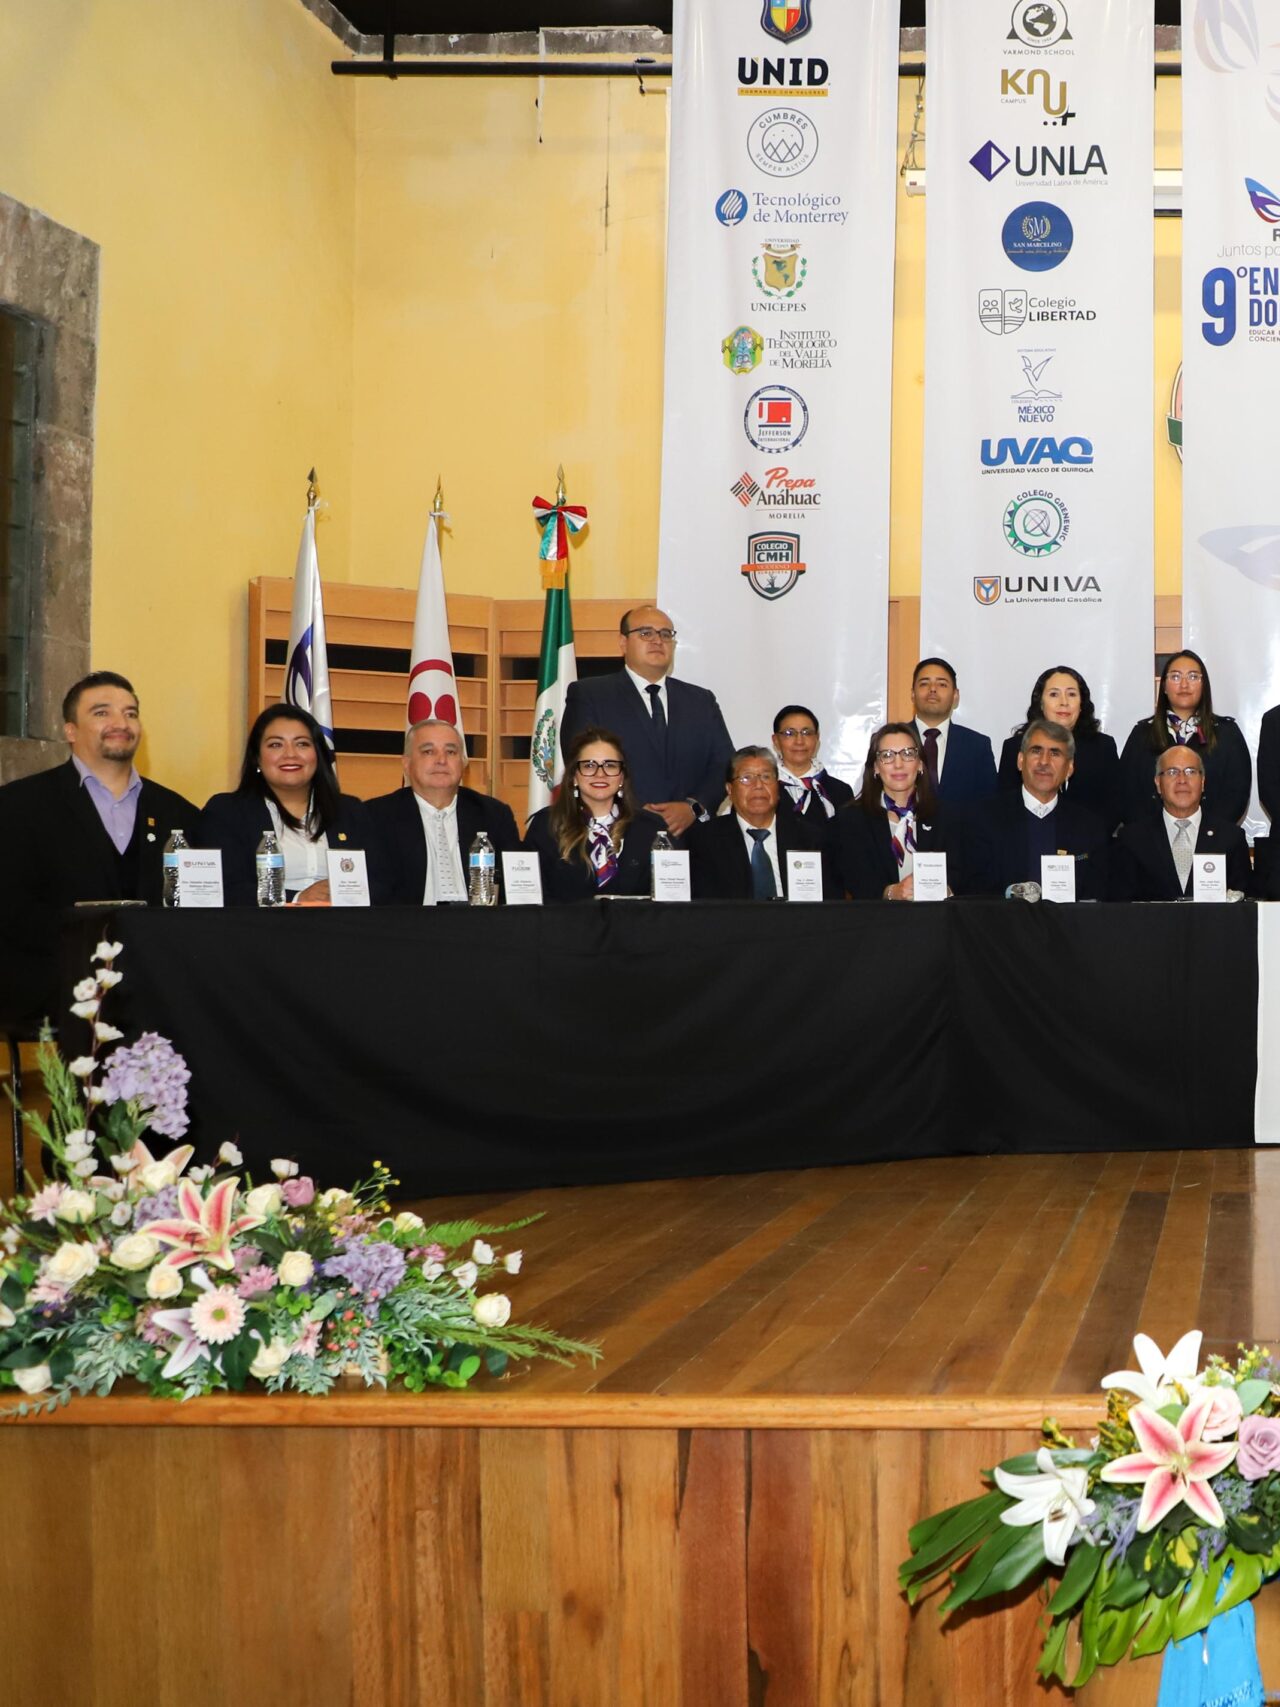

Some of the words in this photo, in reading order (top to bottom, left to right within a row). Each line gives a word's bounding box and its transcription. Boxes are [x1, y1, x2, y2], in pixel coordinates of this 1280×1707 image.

[737, 57, 829, 86] UNID
[758, 112, 808, 130] CUMBRES
[755, 152, 782, 172] SEMPER
[785, 153, 809, 172] ALTIUS
[1015, 145, 1108, 177] UNLA
[752, 192, 841, 210] Tecnológico
[753, 210, 771, 222] de
[774, 210, 849, 226] Monterrey
[1216, 244, 1261, 258] Juntos
[750, 302, 807, 312] UNICEPES
[1029, 297, 1076, 309] Colegio
[1029, 310, 1097, 321] LIBERTAD
[1018, 403, 1055, 414] MÉXICO
[1019, 414, 1054, 423] NUEVO
[758, 429, 792, 437] JEFFERSON
[980, 436, 1094, 467] UVAQ
[765, 466, 817, 491] Prepa
[981, 467, 1025, 475] UNIVERSIDAD
[756, 488, 821, 506] Anáhuac
[1016, 489, 1054, 501] COLEGIO
[757, 551, 790, 562] CMH
[1005, 576, 1102, 592] UNIVA
